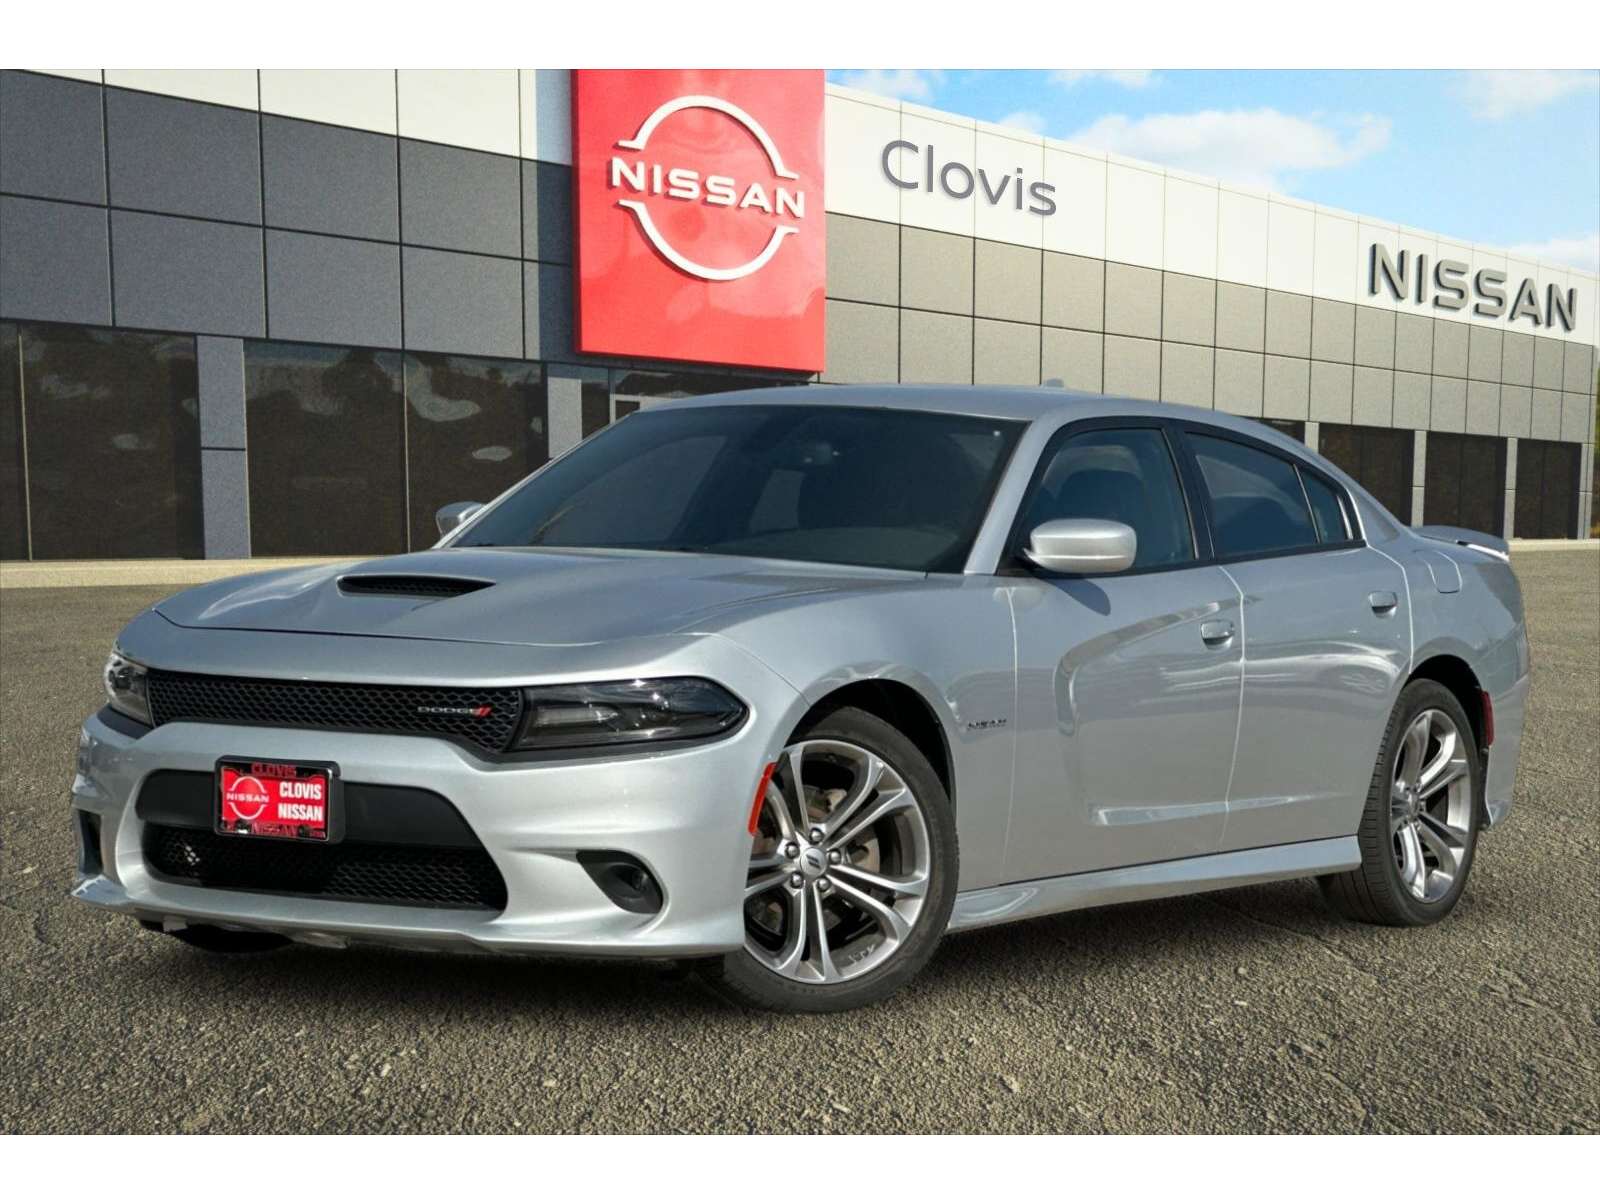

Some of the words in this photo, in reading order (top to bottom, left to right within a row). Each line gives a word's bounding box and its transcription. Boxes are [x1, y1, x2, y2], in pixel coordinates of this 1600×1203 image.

[881, 140, 1057, 216] Clovis
[611, 157, 805, 218] NISSAN
[1368, 243, 1578, 331] NISSAN
[417, 706, 477, 714] DODGE
[251, 762, 297, 778] CLOVIS
[226, 793, 269, 803] NISSAN
[279, 781, 322, 800] CLOVIS
[278, 803, 323, 821] NISSAN
